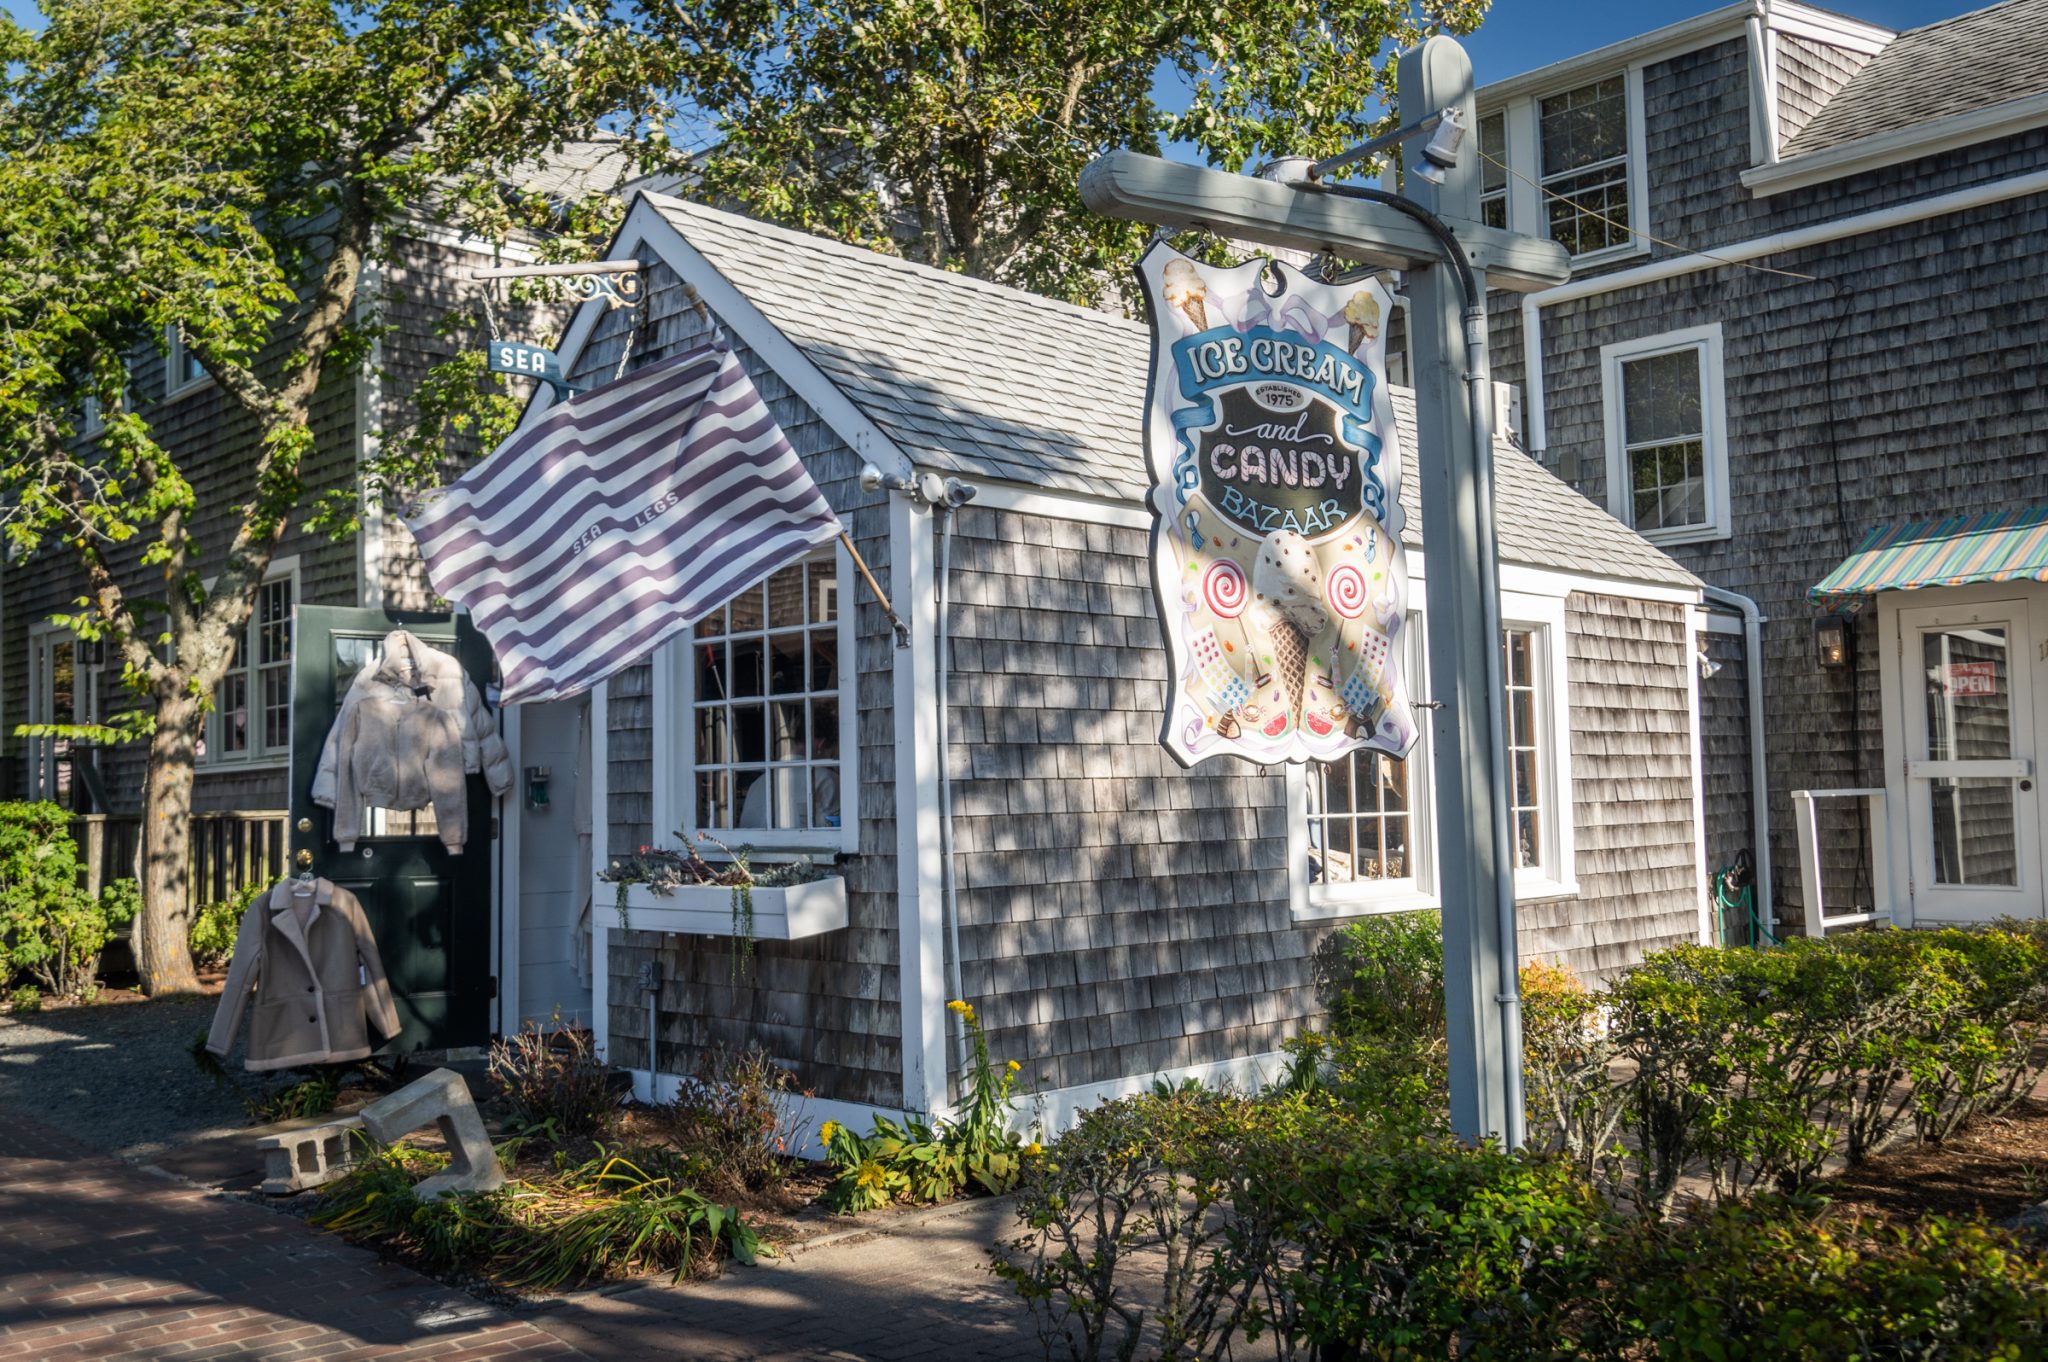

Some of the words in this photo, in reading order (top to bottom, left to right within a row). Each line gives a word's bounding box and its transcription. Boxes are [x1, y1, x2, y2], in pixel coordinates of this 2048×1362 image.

[501, 347, 545, 373] SEA
[1187, 337, 1249, 384] ICE
[1250, 338, 1365, 405] CREAM
[1255, 384, 1302, 399] ESTABLISHED
[1266, 393, 1294, 406] 1975
[1225, 411, 1334, 445] and
[1210, 443, 1351, 490] CANDY
[573, 524, 602, 554] SEA
[634, 492, 679, 528] LEGS
[1220, 485, 1348, 536] BAZAAR
[1947, 675, 1991, 693] OPEN
